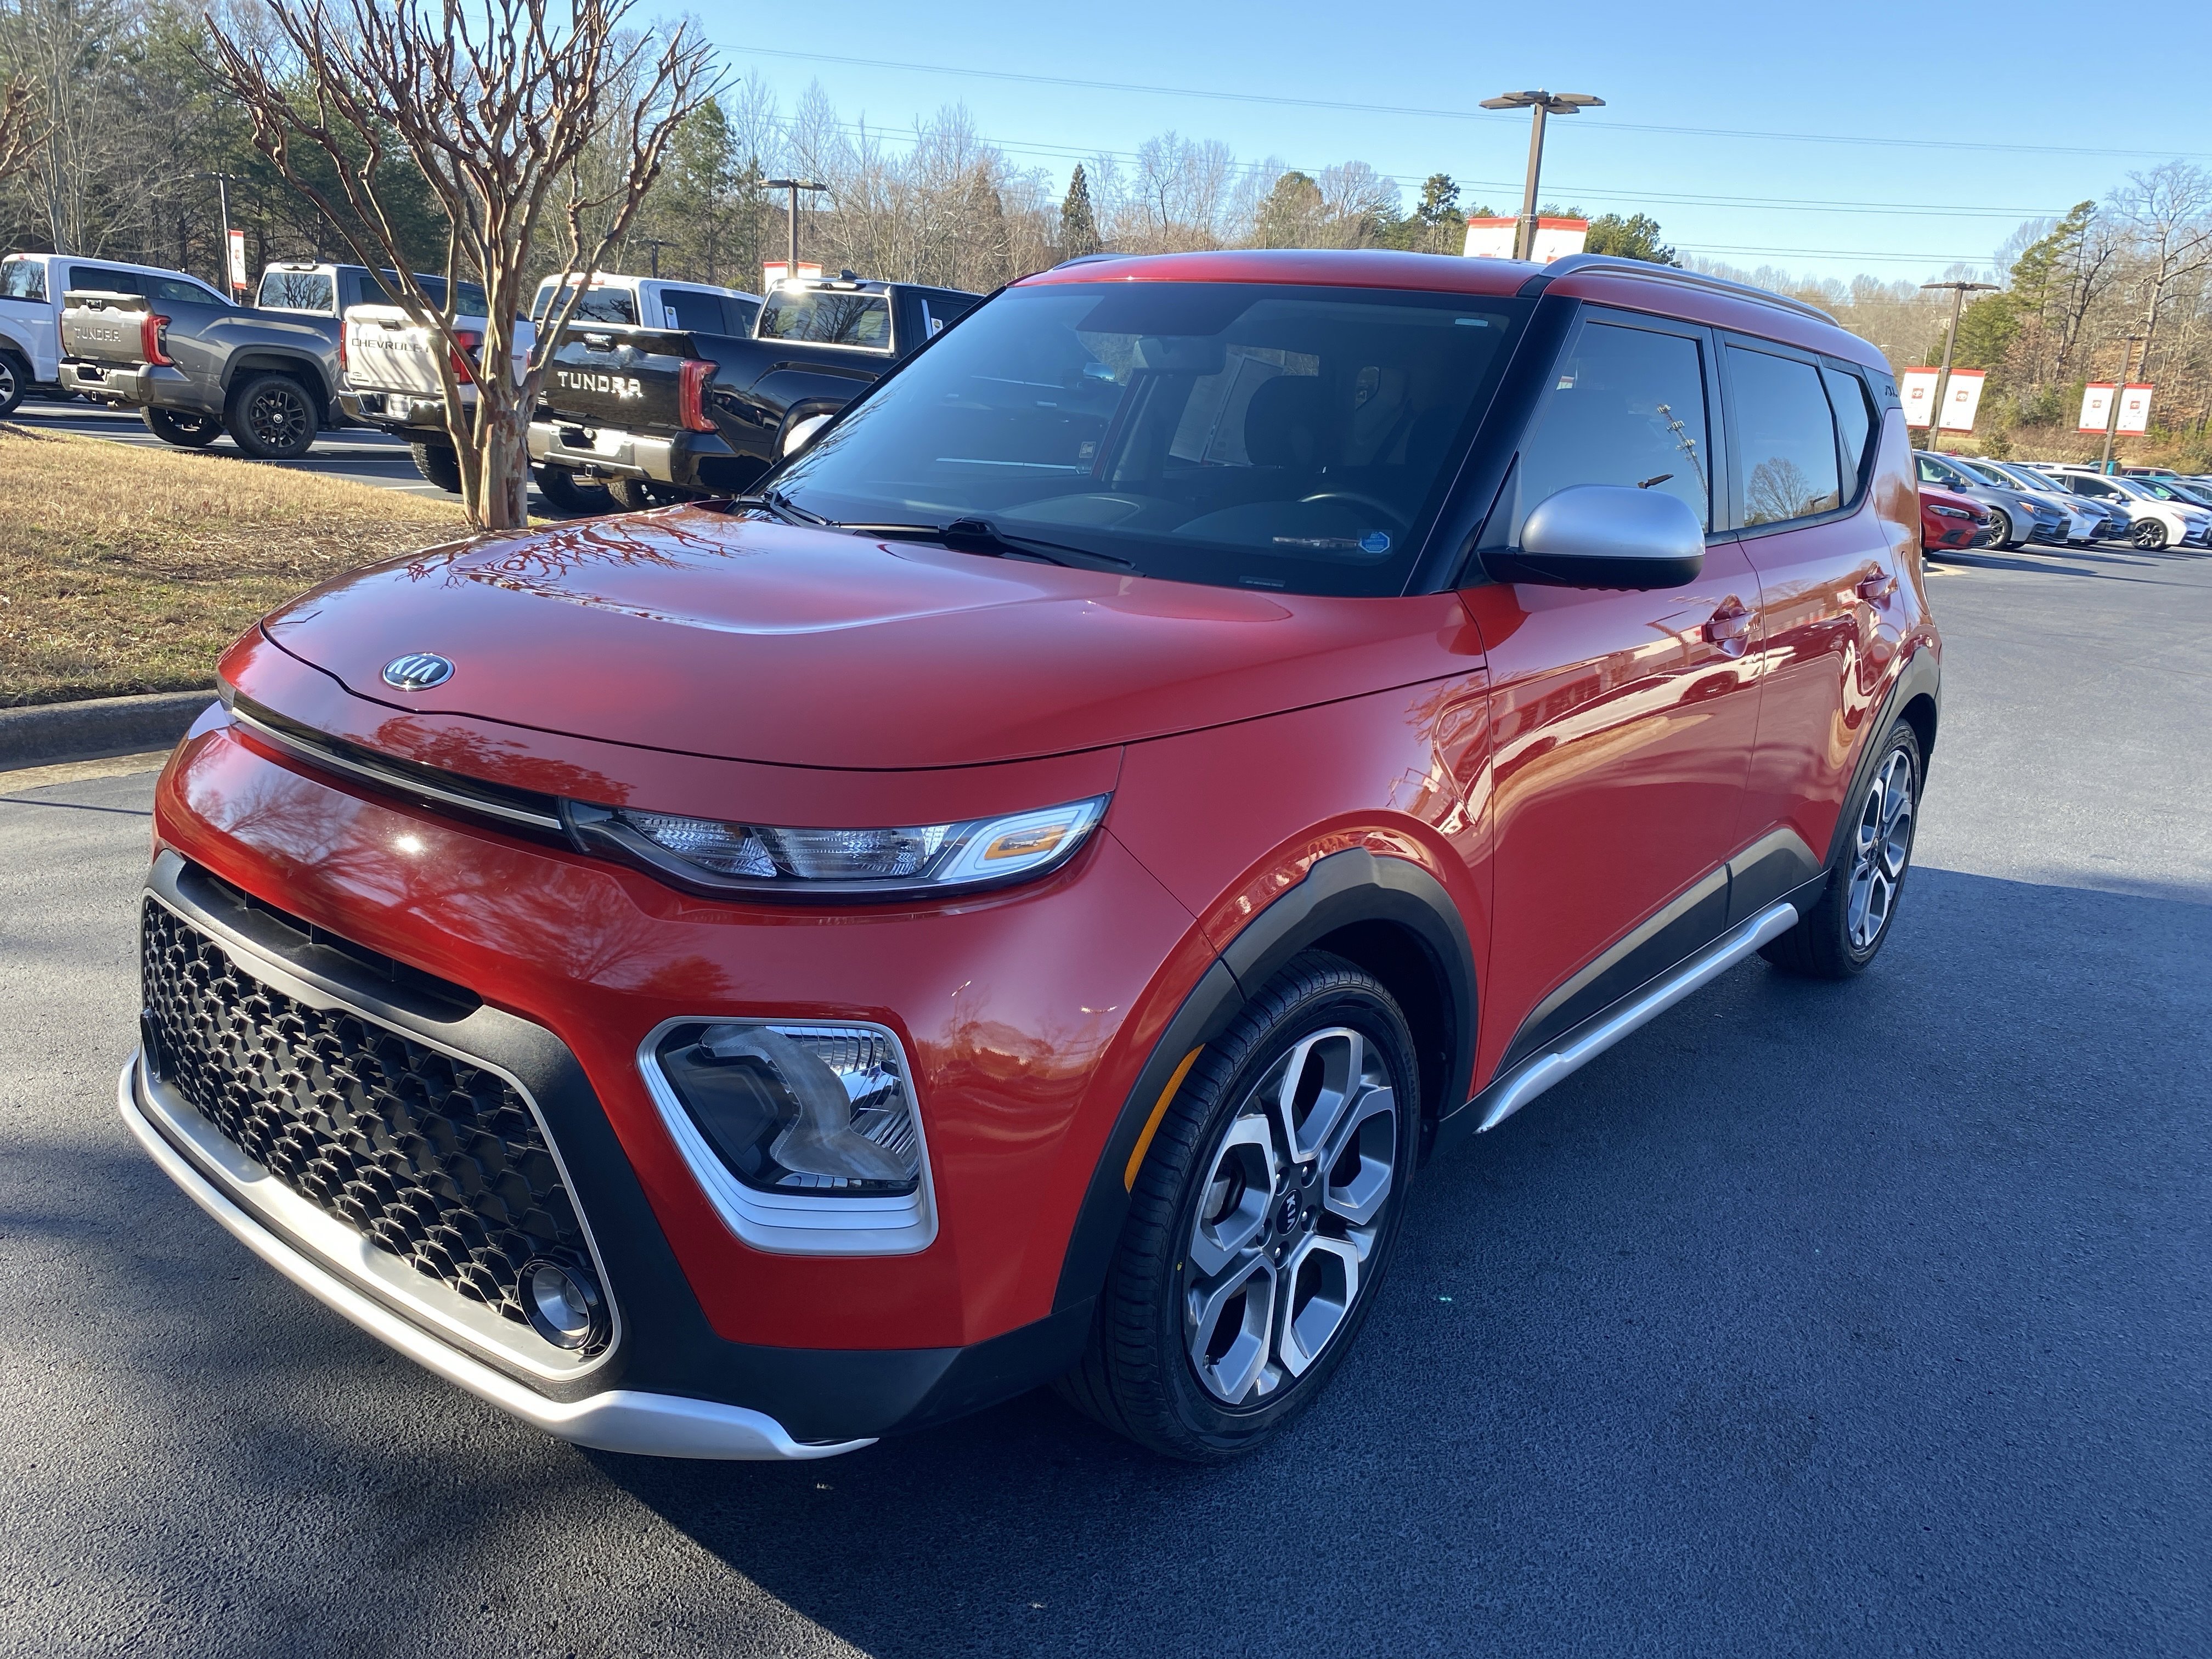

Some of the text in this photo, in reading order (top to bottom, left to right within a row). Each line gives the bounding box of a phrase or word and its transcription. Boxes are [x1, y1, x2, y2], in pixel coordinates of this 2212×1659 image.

[74, 326, 121, 342] TUNDRA
[557, 371, 642, 398] TUNDRA
[387, 656, 441, 683] KIA
[1286, 1194, 1296, 1230] KIA
